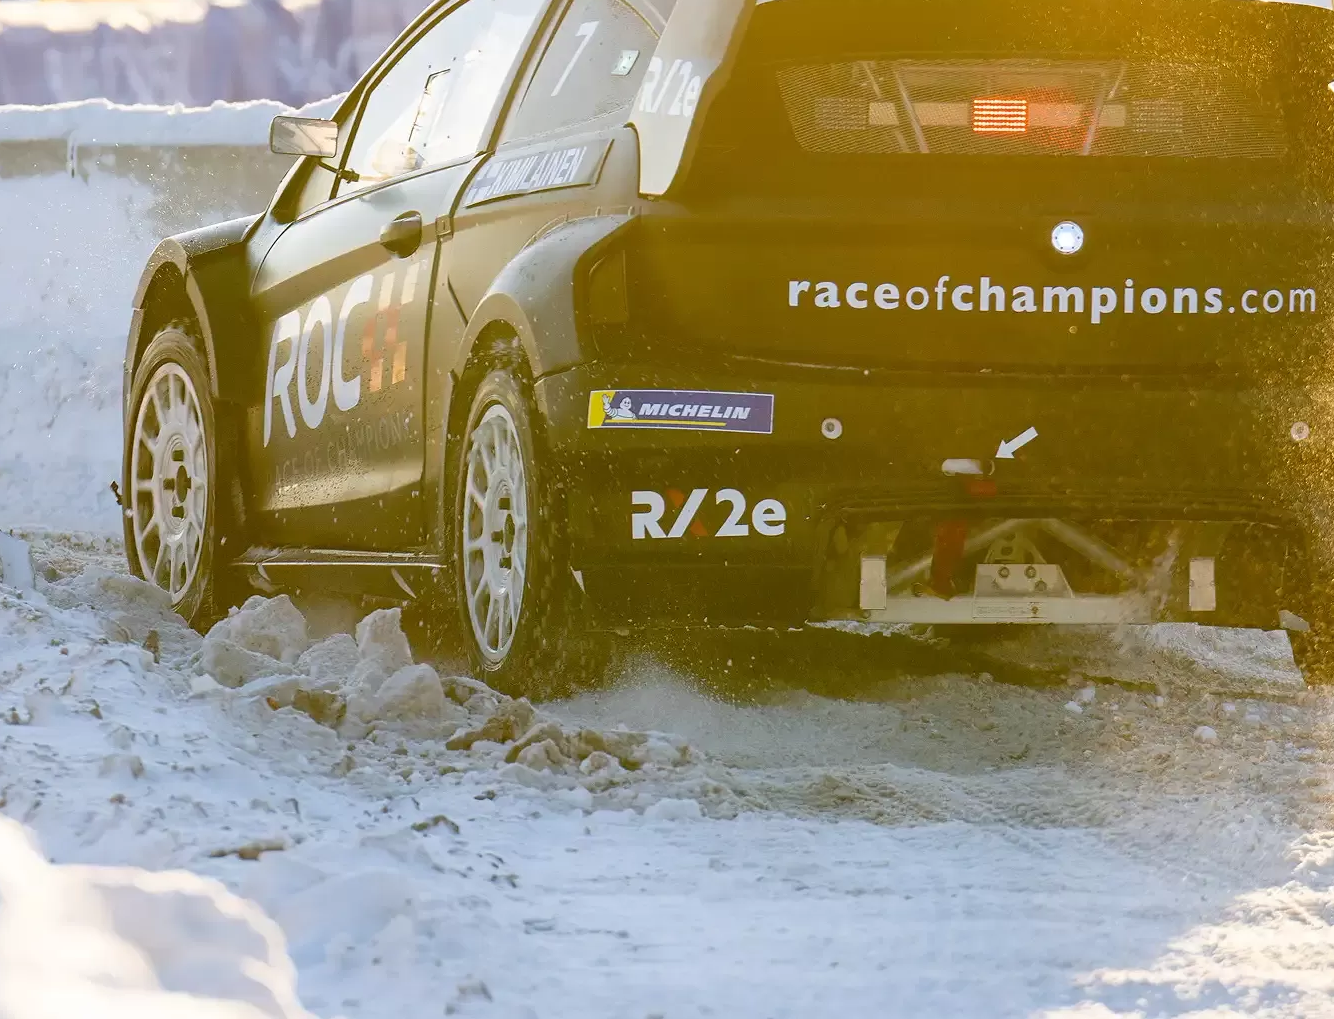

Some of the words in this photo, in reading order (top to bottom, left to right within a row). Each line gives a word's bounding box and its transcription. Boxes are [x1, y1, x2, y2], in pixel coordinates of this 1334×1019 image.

[551, 20, 600, 97] 7
[788, 274, 1318, 325] raceofchampions.com
[263, 273, 374, 448] ROC
[638, 402, 752, 420] MICHELIN
